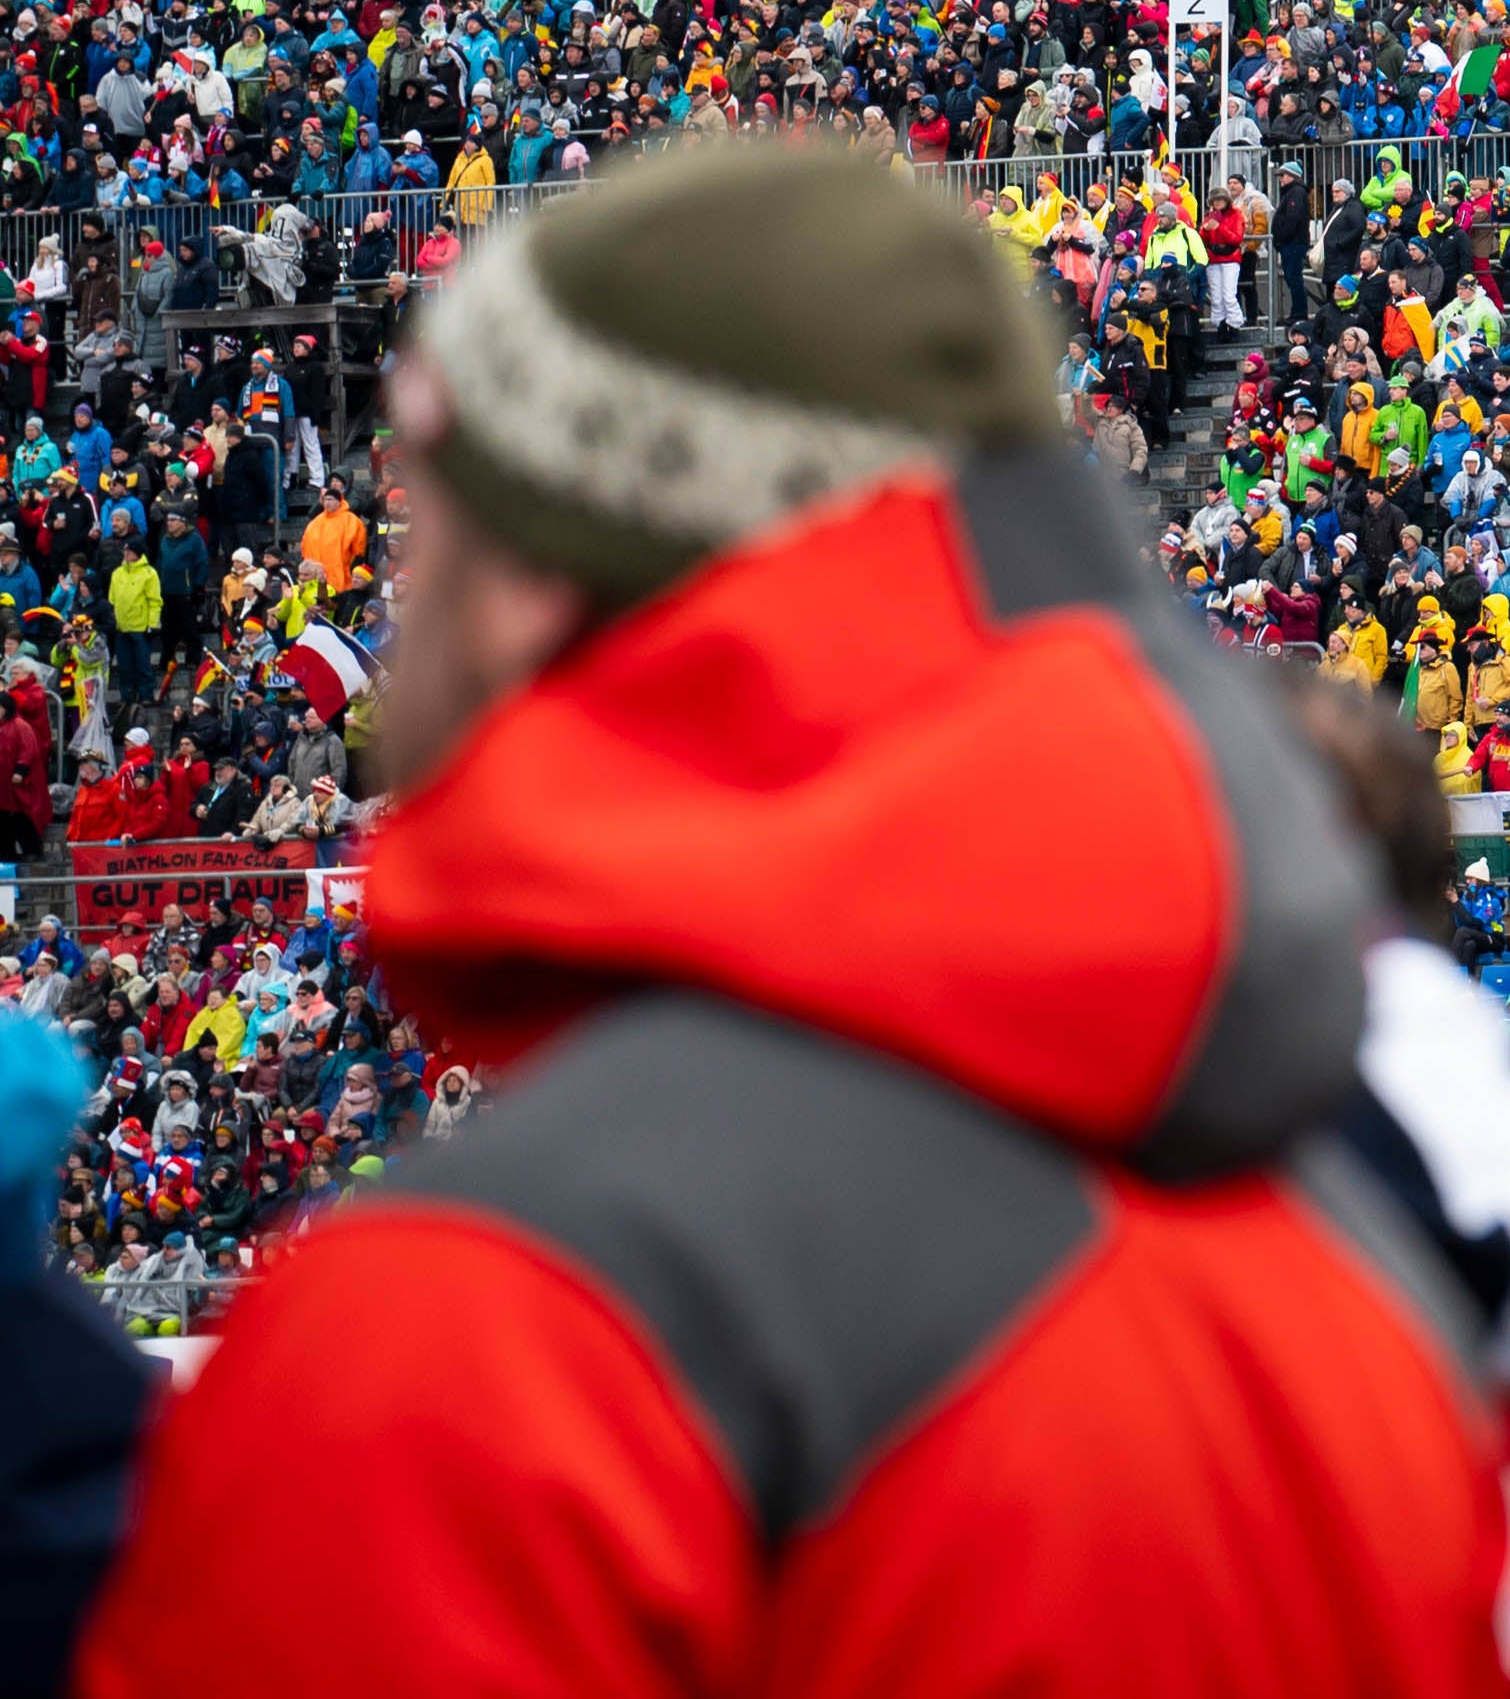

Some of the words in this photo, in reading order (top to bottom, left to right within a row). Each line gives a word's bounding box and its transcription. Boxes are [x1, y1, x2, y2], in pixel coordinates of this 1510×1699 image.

[107, 852, 197, 875] BIATHLON
[202, 851, 290, 870] FAN-CLUB
[91, 881, 163, 908] GUT
[177, 877, 307, 906] DRAUF
